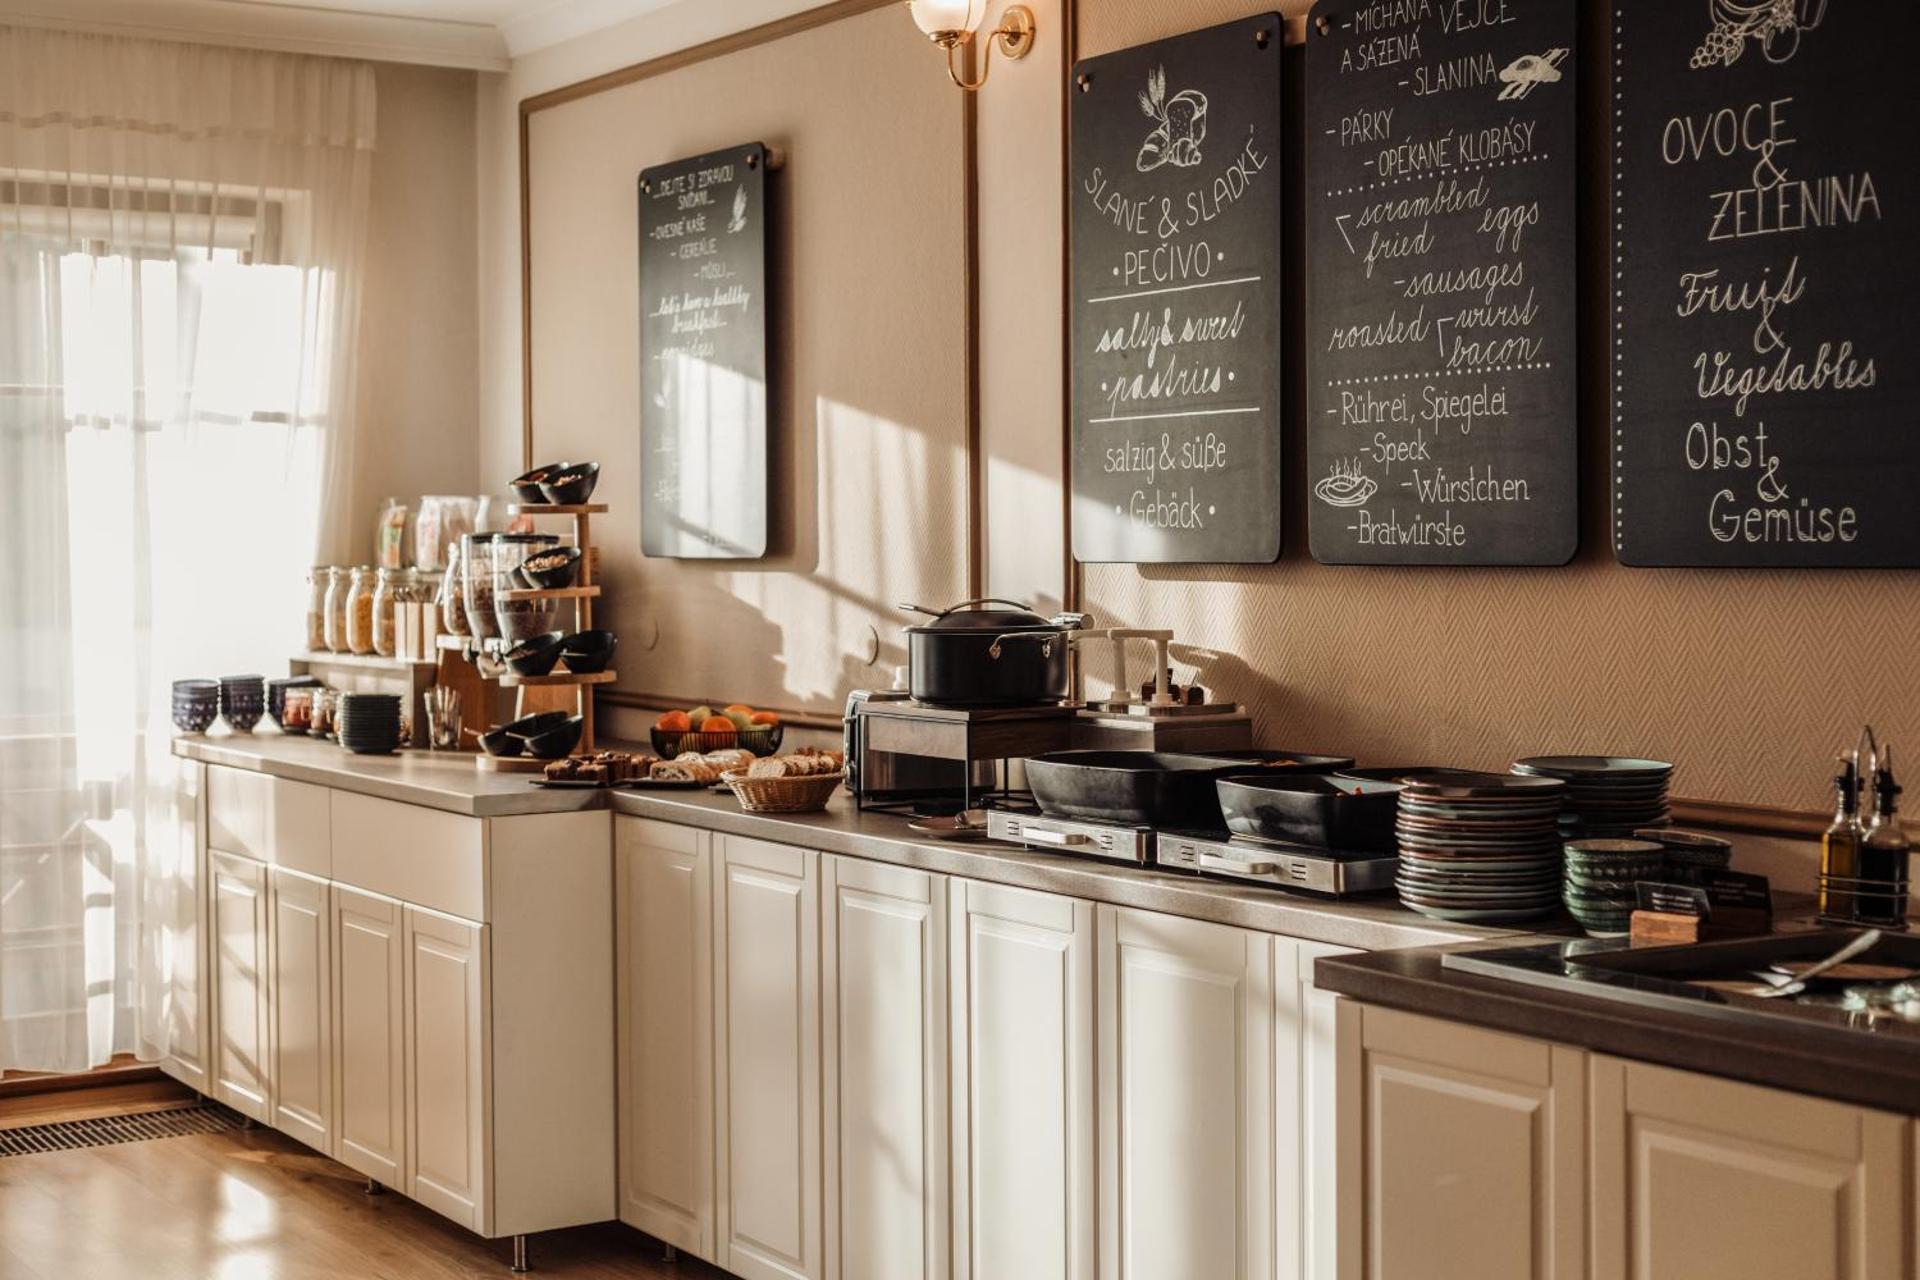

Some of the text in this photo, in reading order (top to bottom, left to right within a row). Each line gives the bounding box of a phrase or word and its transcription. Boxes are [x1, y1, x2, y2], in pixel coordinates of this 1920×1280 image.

[1340, 24, 1422, 74] A SÁZENÁ
[1458, 116, 1537, 165] KLOBÁSY
[1662, 97, 1798, 165] OVOCE
[1084, 123, 1269, 239] SLANÉ & SLADKÉ
[1752, 138, 1789, 192] &
[1355, 174, 1540, 254] scrambled eggs
[1706, 171, 1882, 242] ZELENINA
[1363, 220, 1436, 279] fried
[1676, 255, 1808, 318] Fruit
[1327, 303, 1432, 353] roasted
[1446, 334, 1544, 369] bacon
[1753, 295, 1786, 354] &
[1693, 340, 1877, 418] Vegetables
[1420, 382, 1510, 436] Spiegelei
[1103, 439, 1156, 485] salzig
[1158, 432, 1177, 471] &
[1685, 421, 1769, 470] Obst
[1756, 455, 1790, 503] &
[1129, 486, 1204, 529] Gebäck
[1709, 488, 1859, 543] Gemüse
